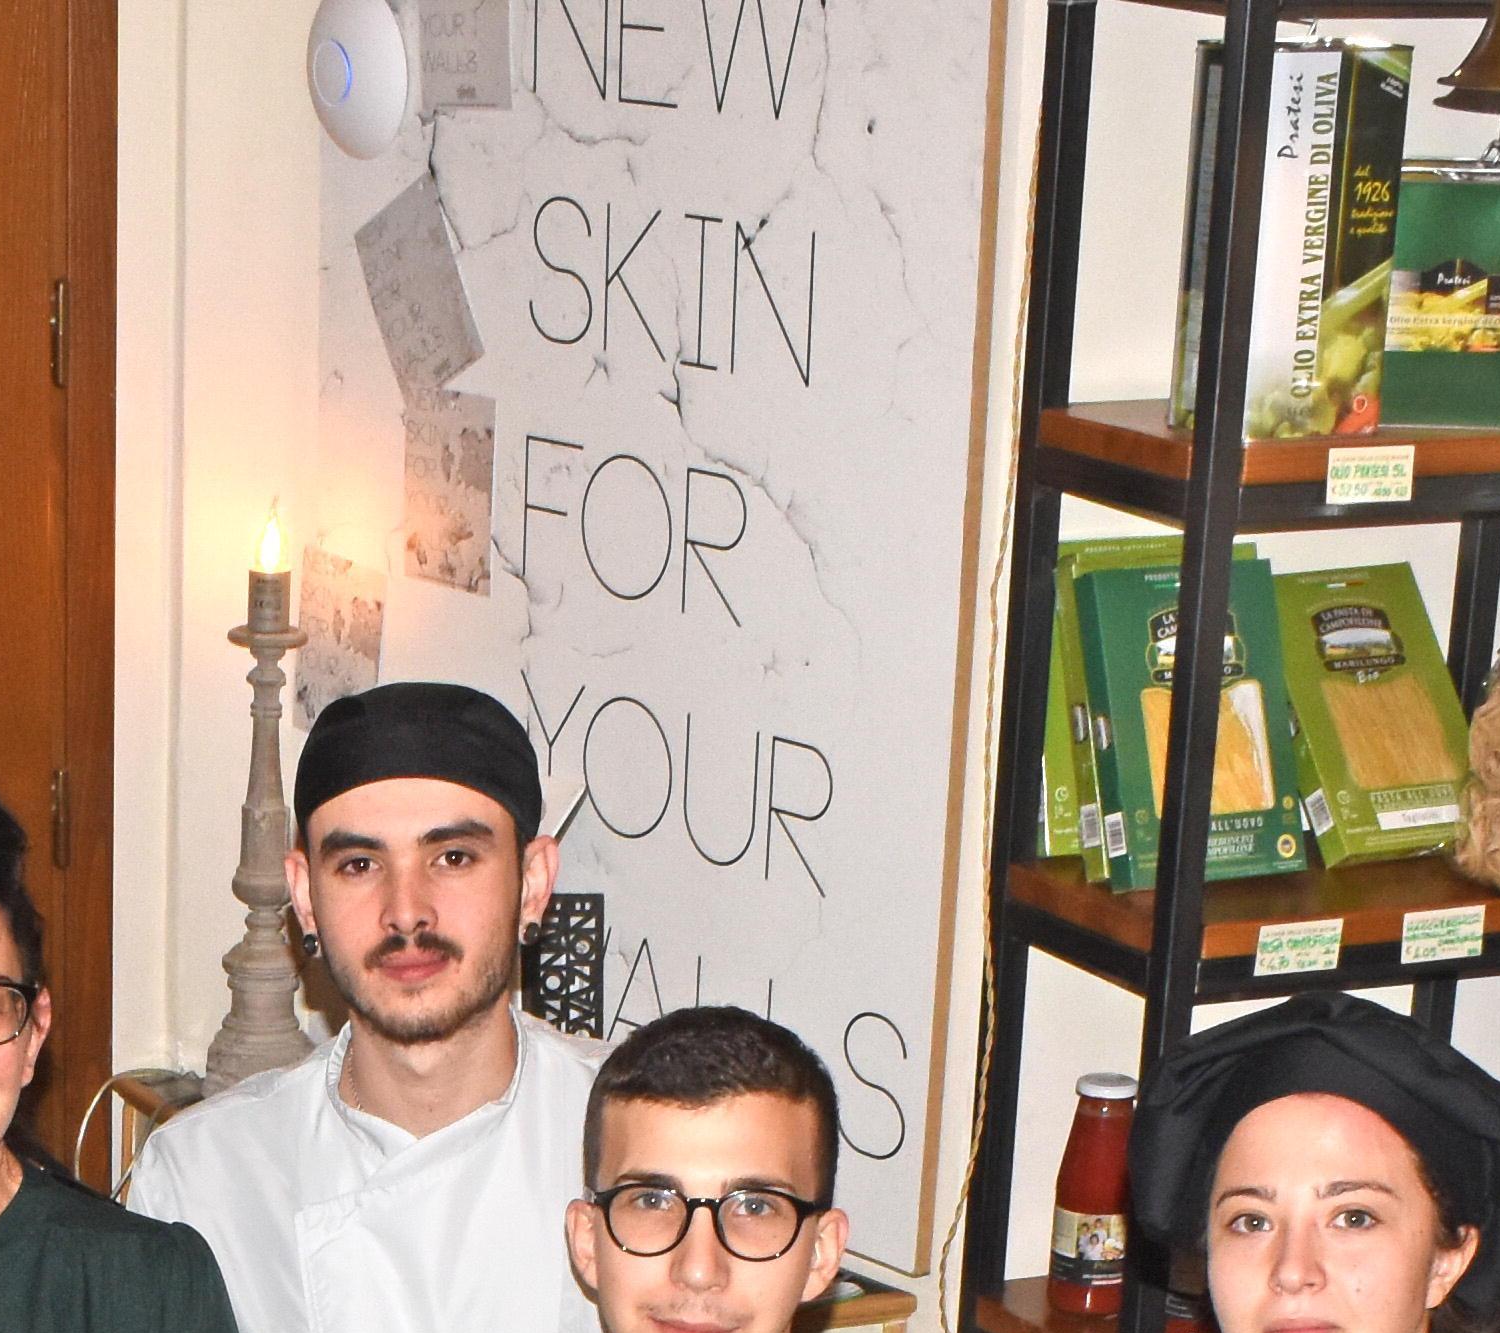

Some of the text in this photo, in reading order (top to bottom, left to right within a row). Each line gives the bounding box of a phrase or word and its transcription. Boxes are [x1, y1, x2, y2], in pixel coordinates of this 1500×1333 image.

[532, 0, 803, 120] NEW
[1276, 73, 1304, 159] Pratesi
[1290, 71, 1338, 399] OLIO EXTRA VERGINE DI OLIVA
[1354, 181, 1392, 203] 1926
[528, 196, 816, 388] SKIN
[521, 435, 748, 628] FOR
[520, 669, 832, 899] YOUR
